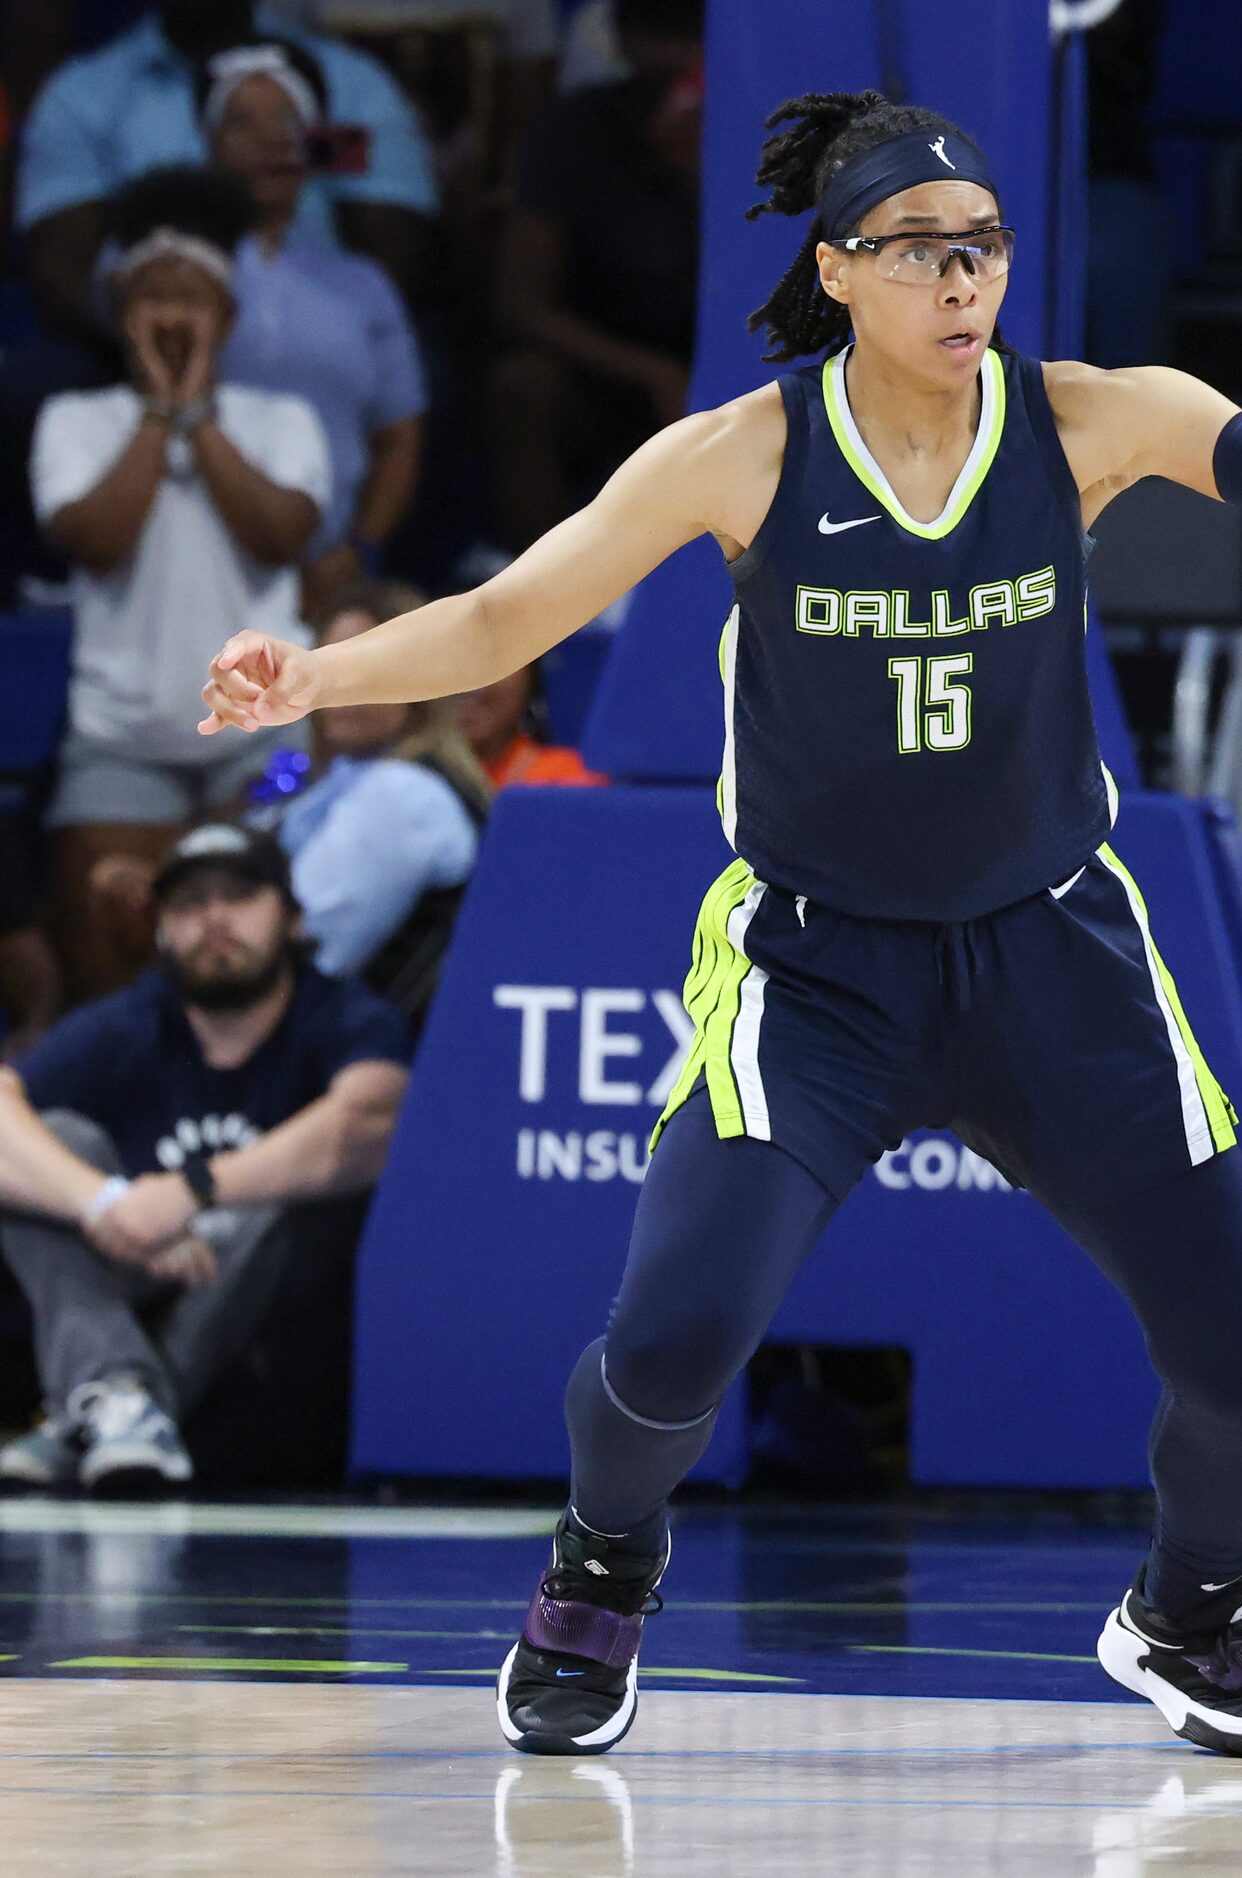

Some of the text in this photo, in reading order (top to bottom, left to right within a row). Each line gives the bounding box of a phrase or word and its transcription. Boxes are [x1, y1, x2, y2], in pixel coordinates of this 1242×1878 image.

[795, 565, 1056, 638] DALLAS
[888, 652, 973, 754] 15
[873, 1138, 1029, 1192] COM
